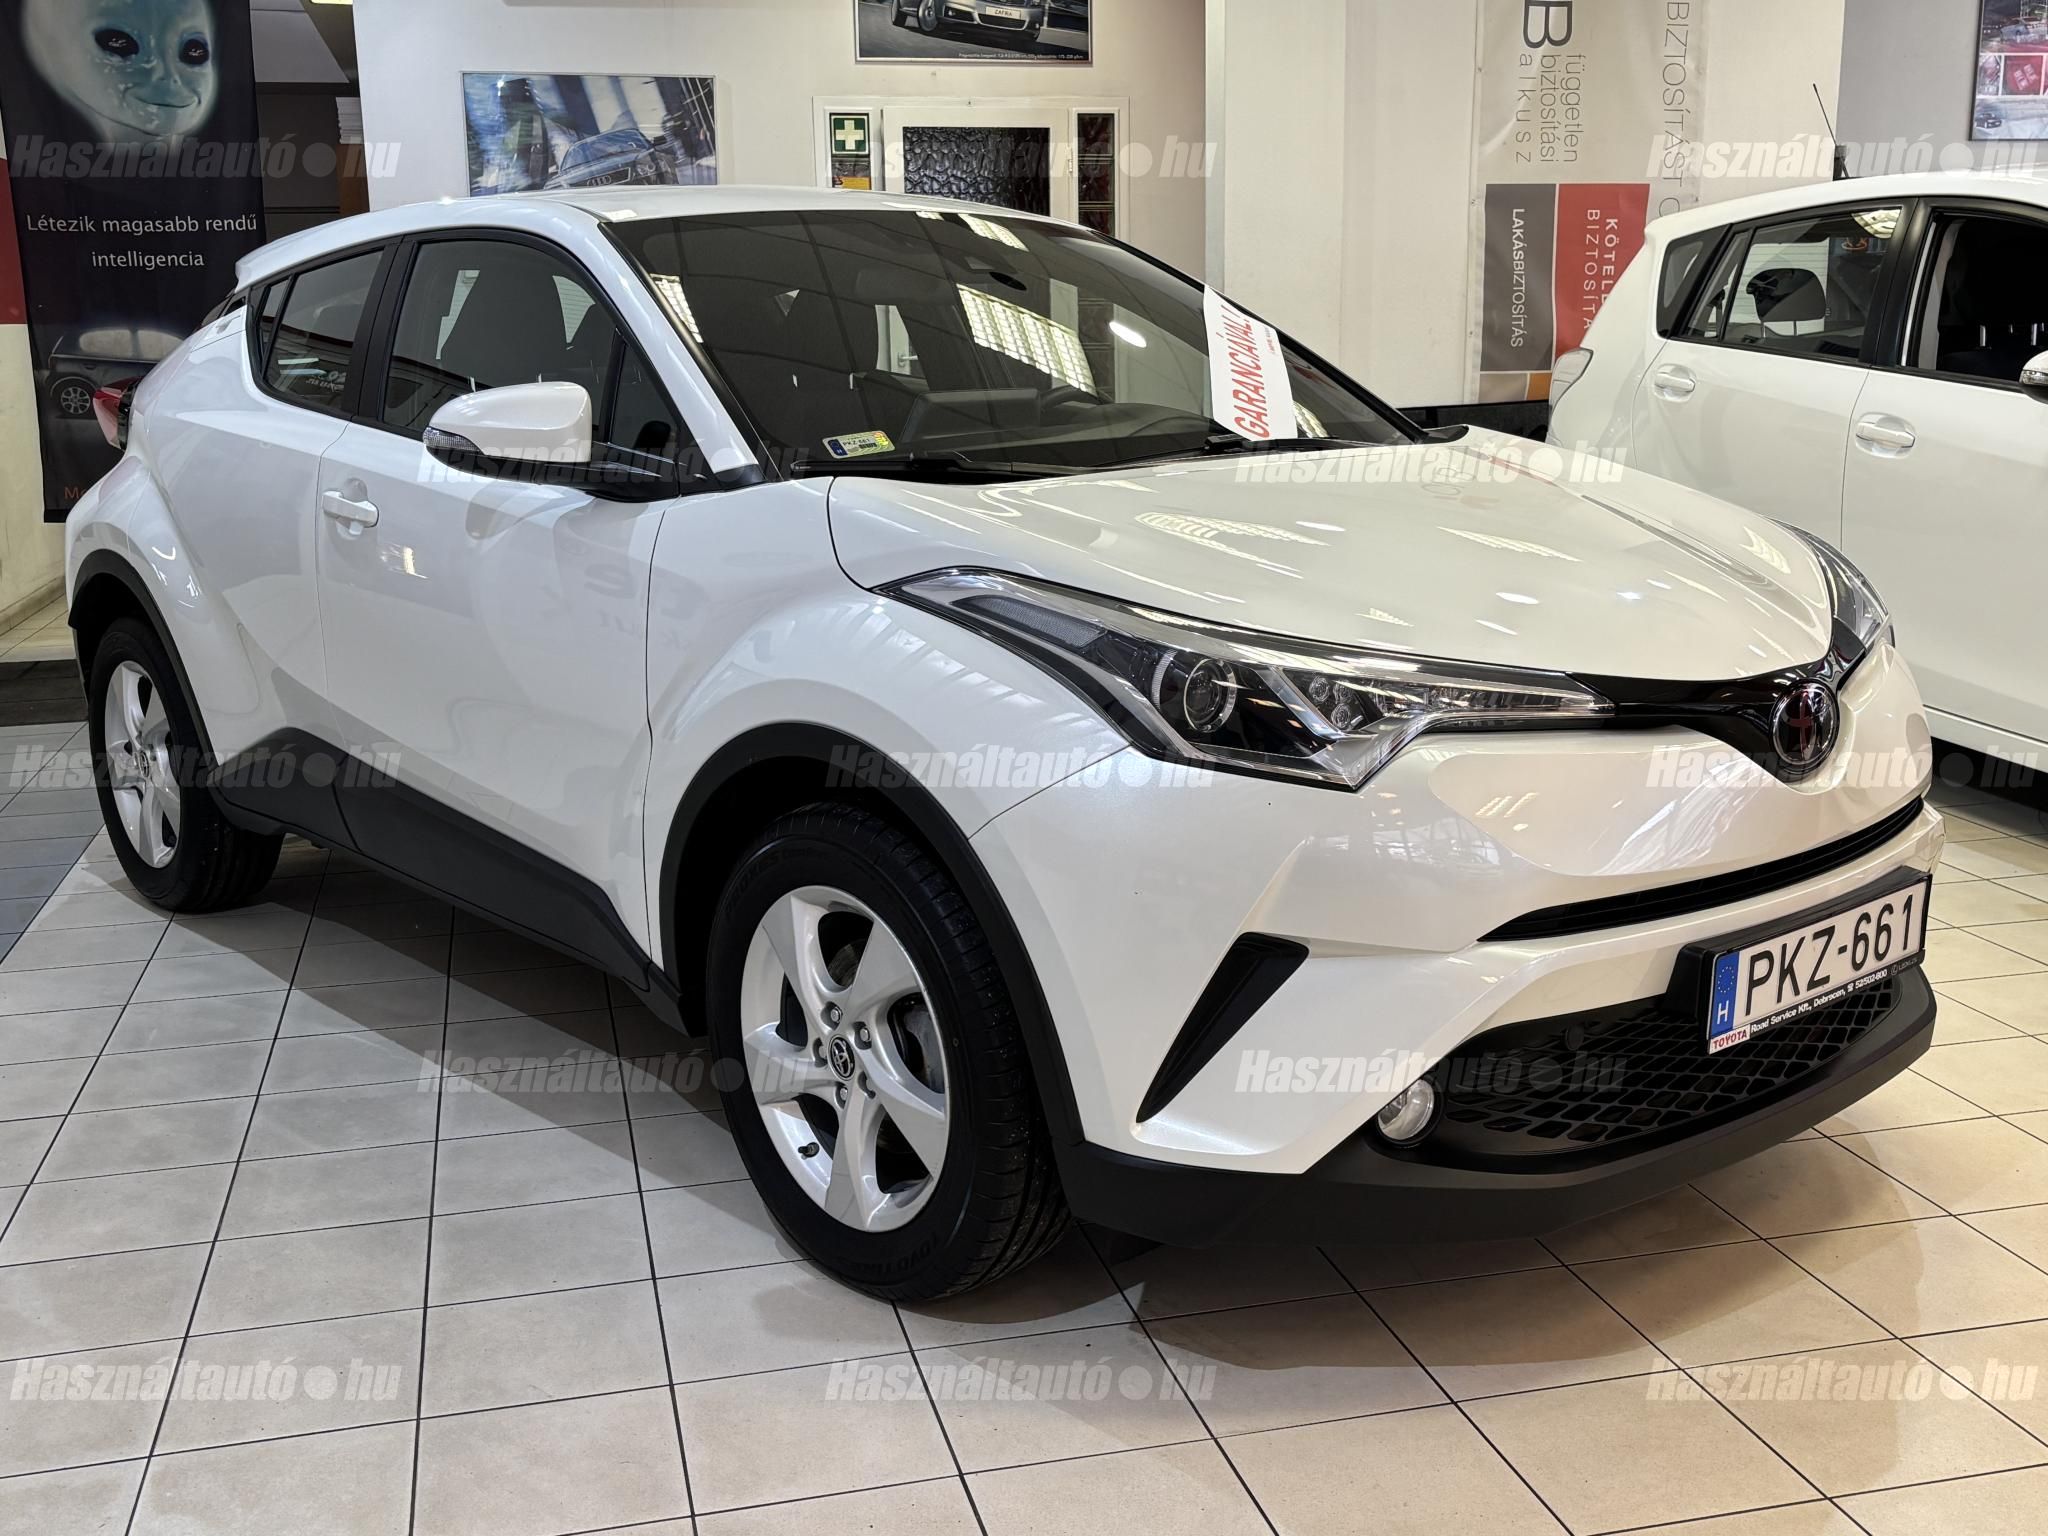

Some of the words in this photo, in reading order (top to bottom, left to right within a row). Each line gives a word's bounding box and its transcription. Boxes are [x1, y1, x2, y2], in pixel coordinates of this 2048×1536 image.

[1540, 54, 1561, 162] biztosítási
[1560, 54, 1586, 162] független
[1662, 2, 1691, 187] BIZTOSÍTÁST
[26, 214, 96, 232] Létezik
[102, 214, 199, 235] magasabb
[205, 213, 257, 231] rendű
[92, 251, 204, 270] intelligencia
[1510, 208, 1527, 347] LAKÁSBIZTOSÍTÁS
[1745, 894, 1913, 1016] PKZ-661
[1713, 1029, 1747, 1049] TOYOTA
[1717, 1000, 1729, 1025] H
[1750, 1018, 1769, 1033] Road
[1770, 1008, 1797, 1026] Service
